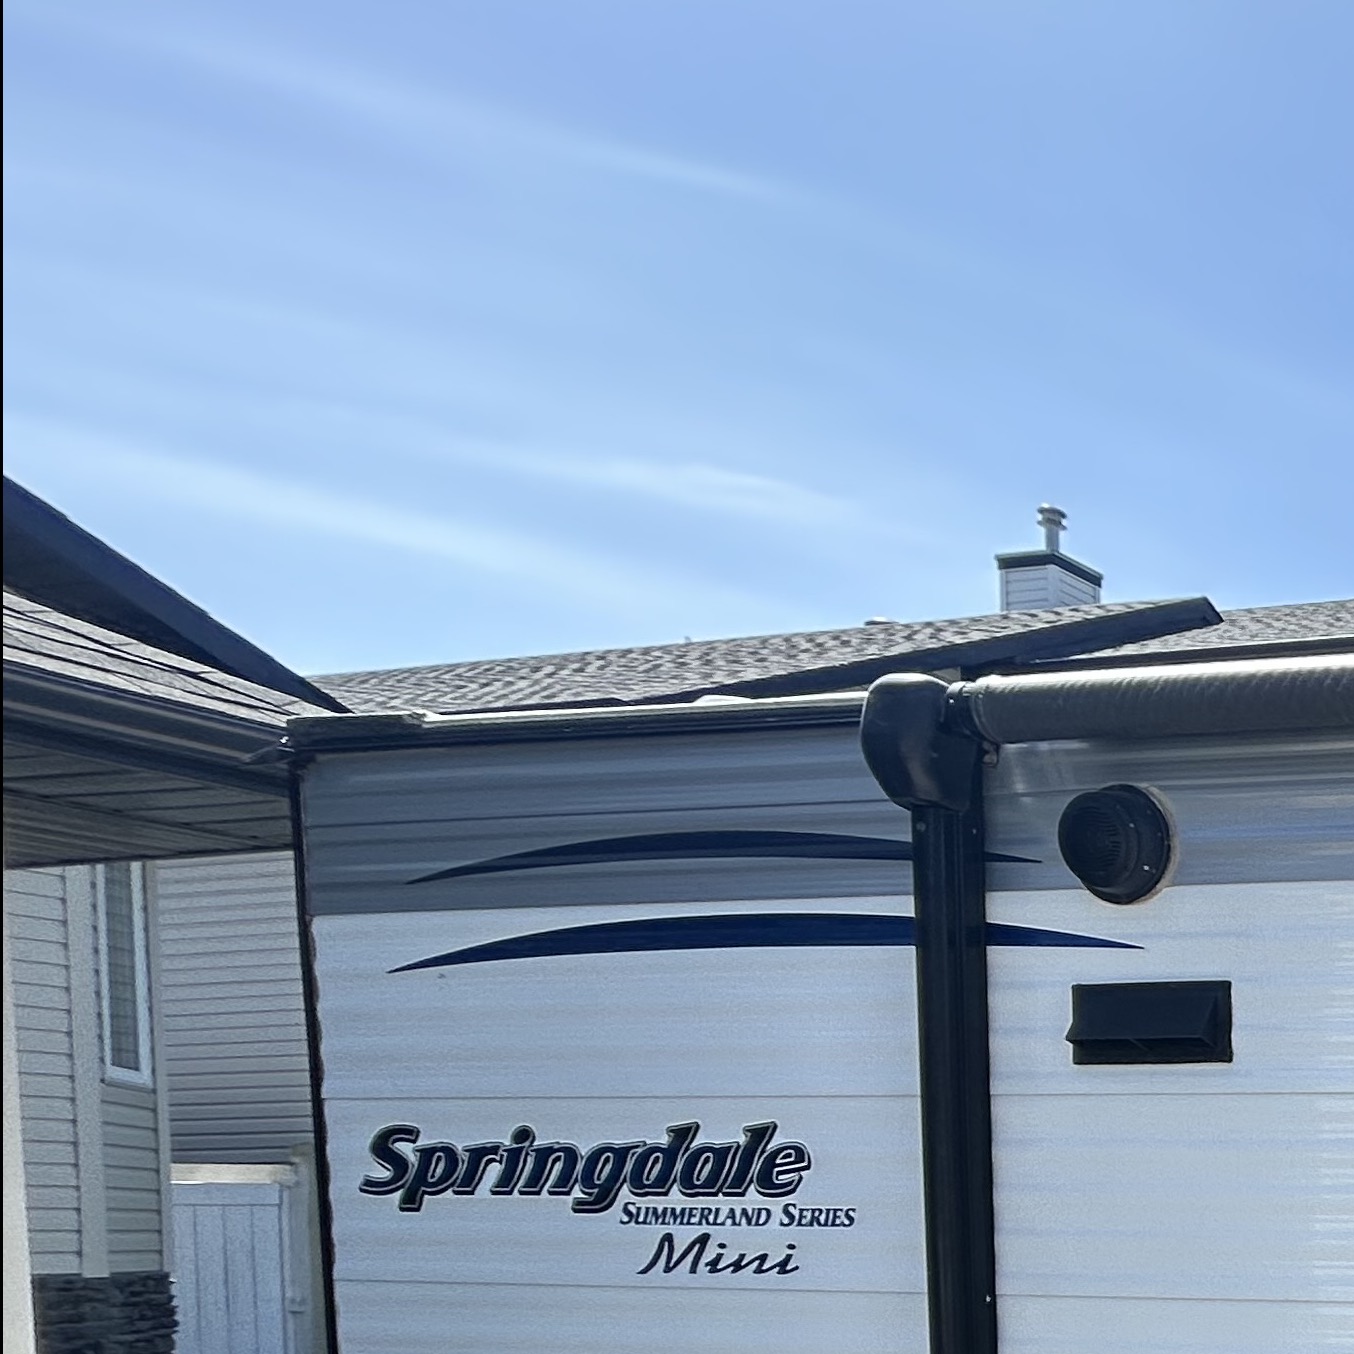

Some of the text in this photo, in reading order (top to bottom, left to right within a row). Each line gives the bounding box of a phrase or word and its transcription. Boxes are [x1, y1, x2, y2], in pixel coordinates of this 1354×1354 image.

[359, 1121, 811, 1213] Springdale
[620, 1203, 856, 1228] SUMMERLAND SERIES
[636, 1232, 799, 1275] Mini
